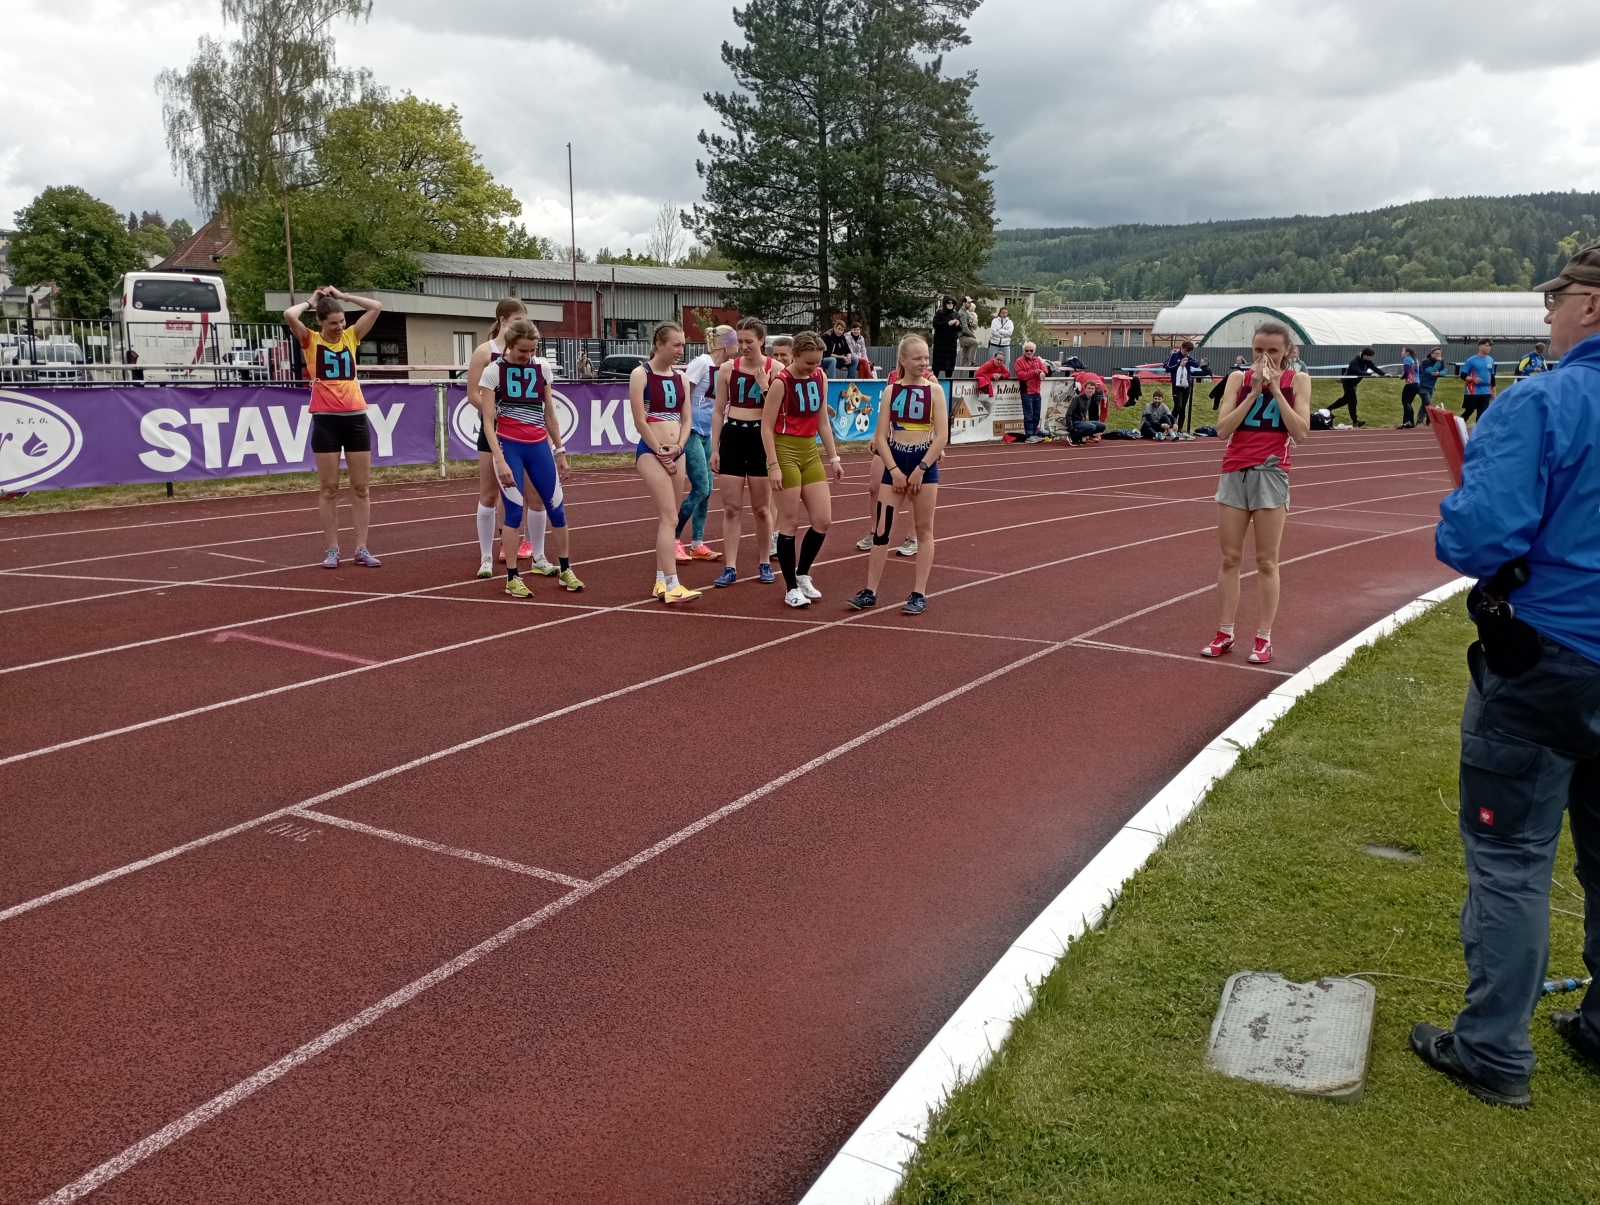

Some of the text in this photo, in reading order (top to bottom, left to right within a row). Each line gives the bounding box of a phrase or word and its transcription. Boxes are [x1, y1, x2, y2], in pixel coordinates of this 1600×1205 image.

[324, 349, 351, 379] 51
[506, 367, 539, 398] 62
[661, 380, 677, 409] 8
[737, 376, 760, 404] 14
[795, 381, 820, 412] 18
[892, 388, 925, 419] 46
[1244, 393, 1280, 428] 24
[138, 403, 405, 473] STAVY
[894, 444, 913, 453] NIKE
